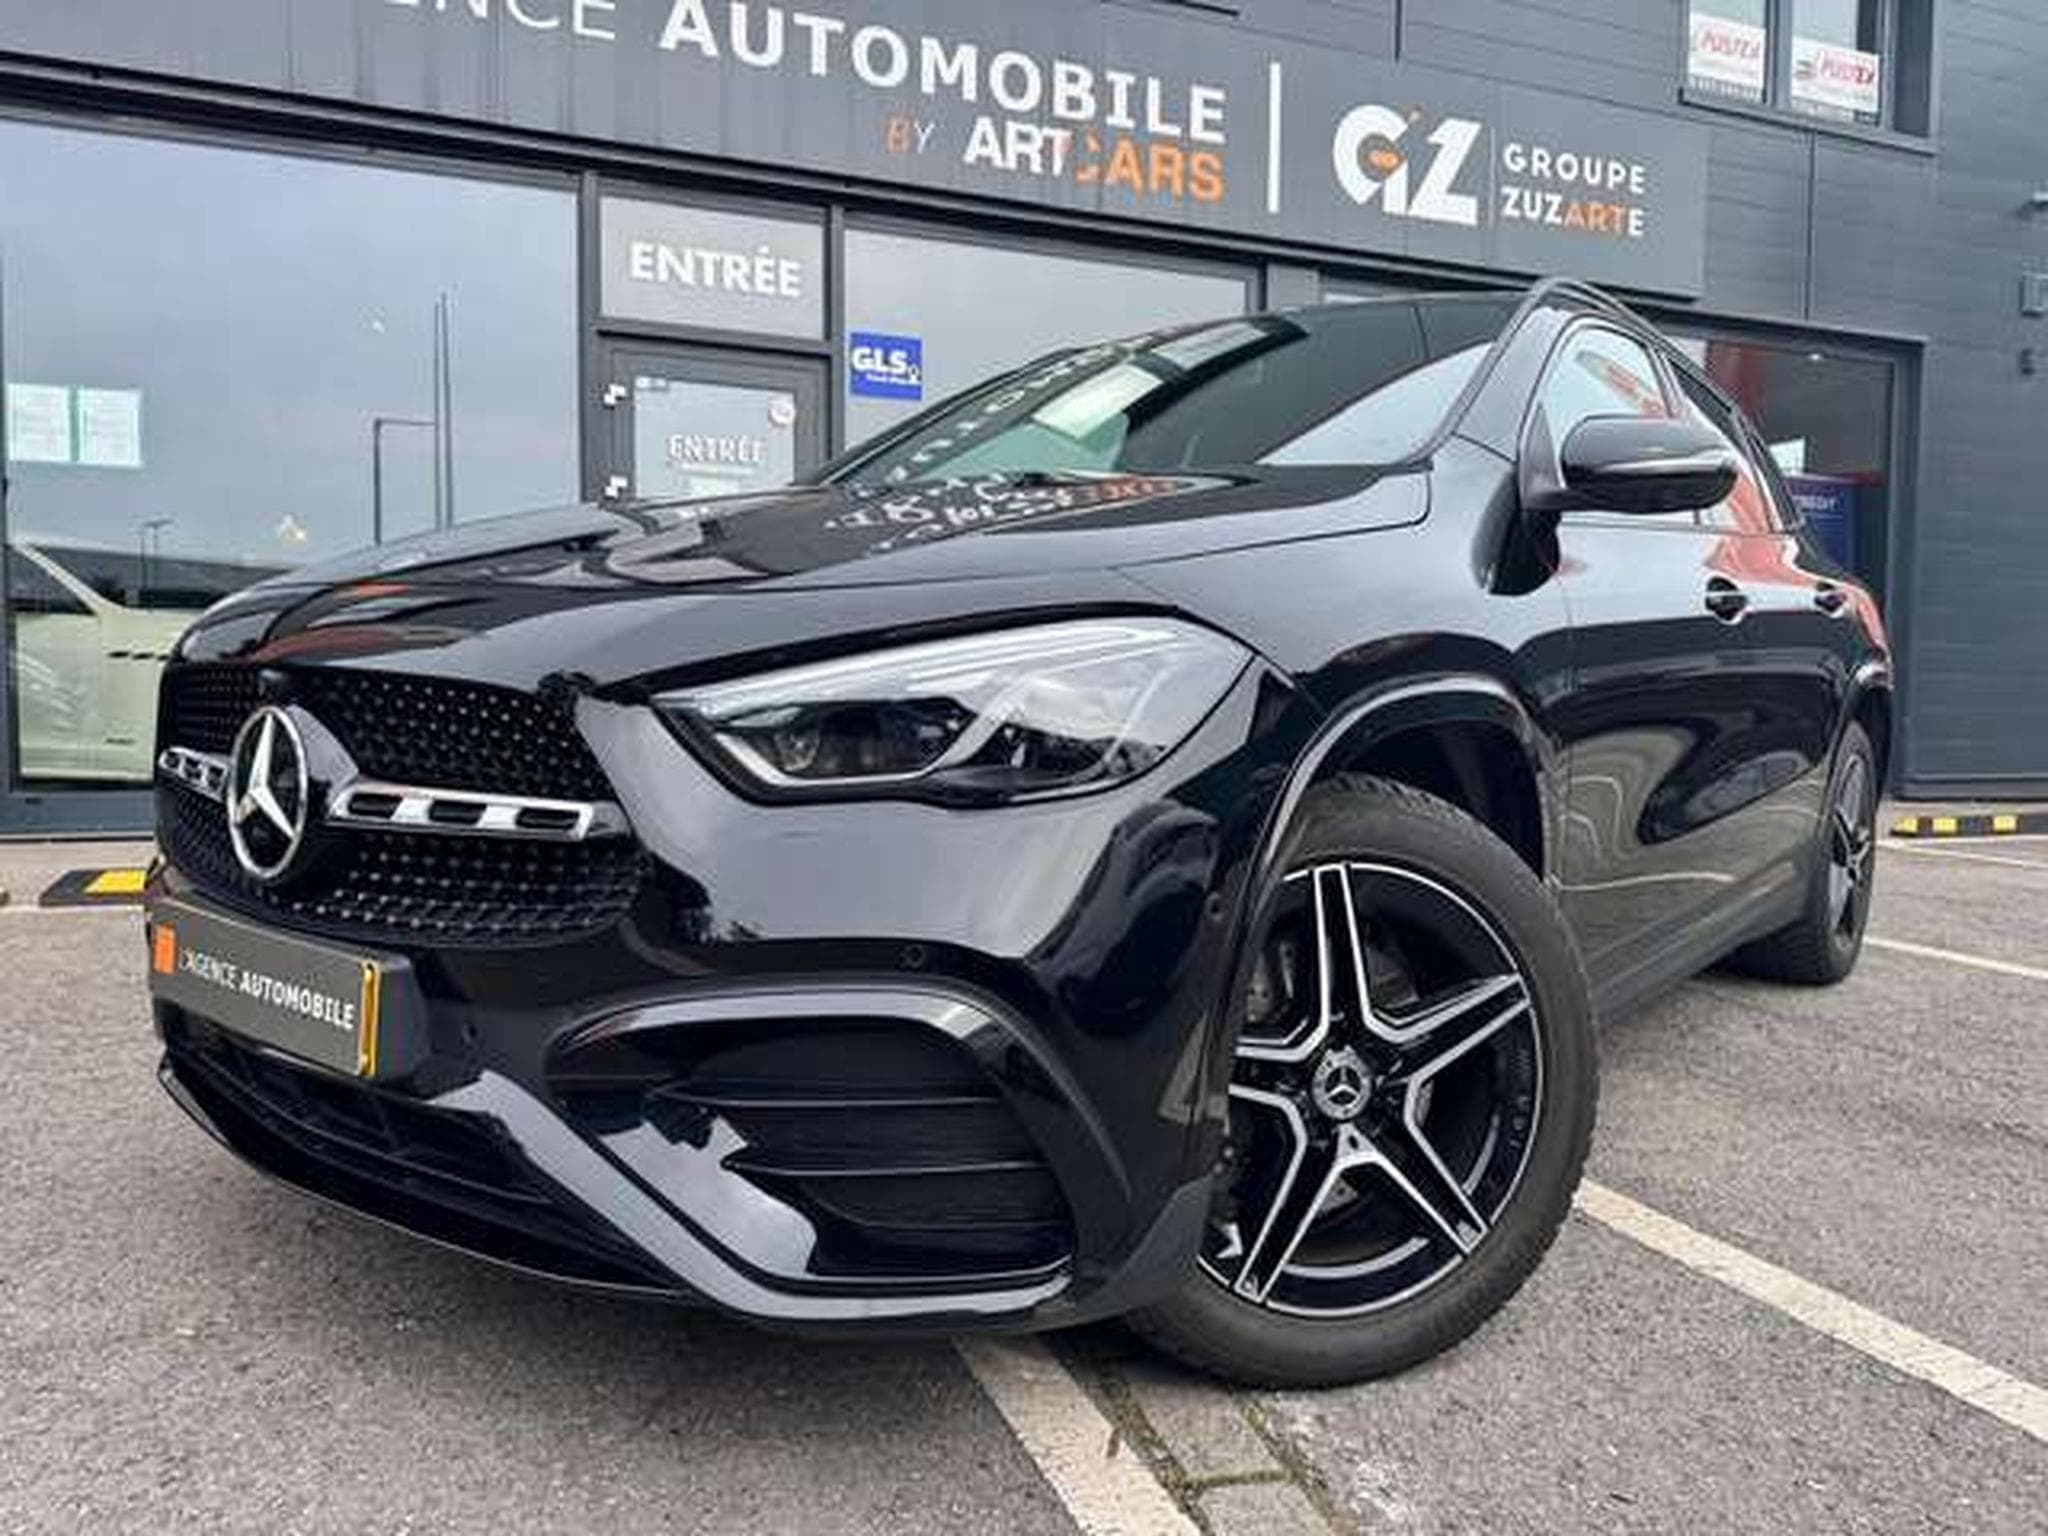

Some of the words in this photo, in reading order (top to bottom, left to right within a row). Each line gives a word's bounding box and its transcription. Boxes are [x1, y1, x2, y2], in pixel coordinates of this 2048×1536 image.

[659, 0, 1227, 144] AUTOMOBILE
[887, 111, 936, 154] BY
[1502, 142, 1646, 194] GROUPE
[1500, 185, 1645, 237] ZUZARTE
[629, 240, 802, 298] ENTRÉE
[852, 345, 908, 375] GLS
[239, 968, 355, 1030] AUTOMOBILE
